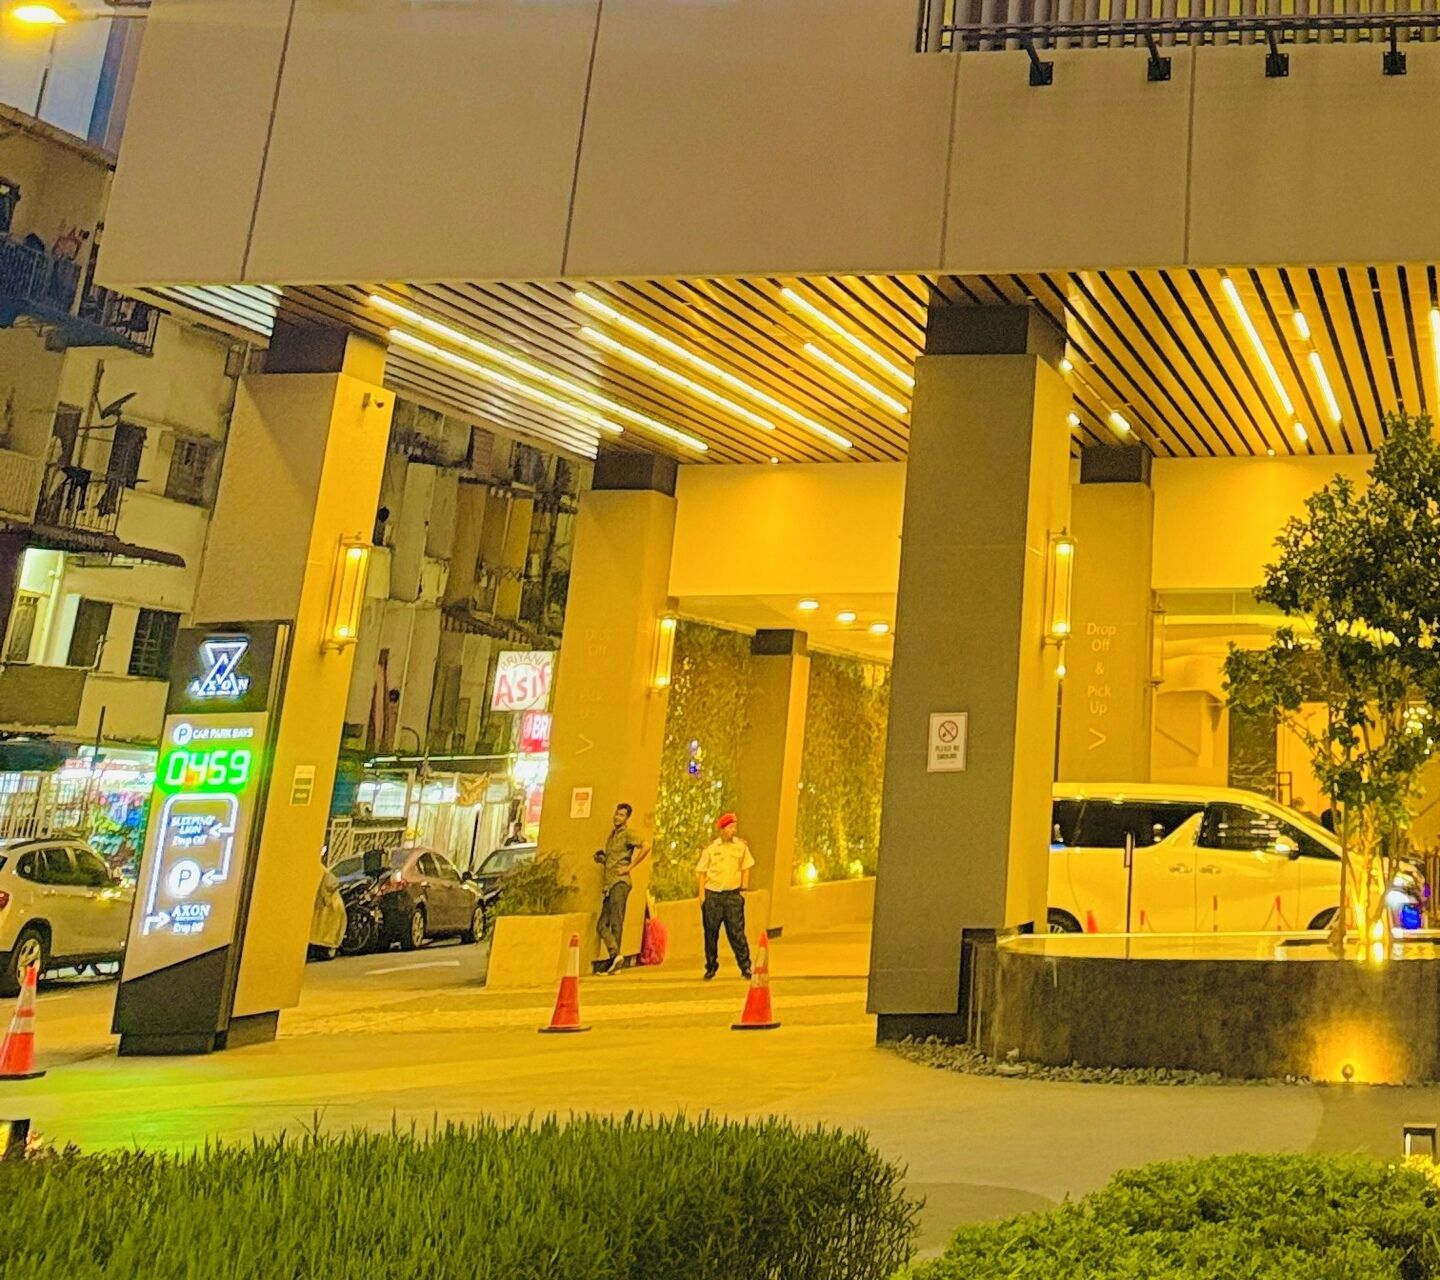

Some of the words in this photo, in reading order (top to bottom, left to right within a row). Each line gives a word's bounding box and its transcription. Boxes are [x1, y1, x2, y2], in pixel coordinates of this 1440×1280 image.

[1086, 622, 1116, 637] Drop
[1091, 638, 1111, 652] Off
[500, 652, 545, 671] BRIYANI
[1095, 661, 1105, 676] &
[1087, 684, 1112, 698] Pick
[1089, 701, 1108, 717] Up
[193, 728, 209, 739] CAR
[210, 728, 232, 739] PARK
[171, 904, 211, 917] AXON
